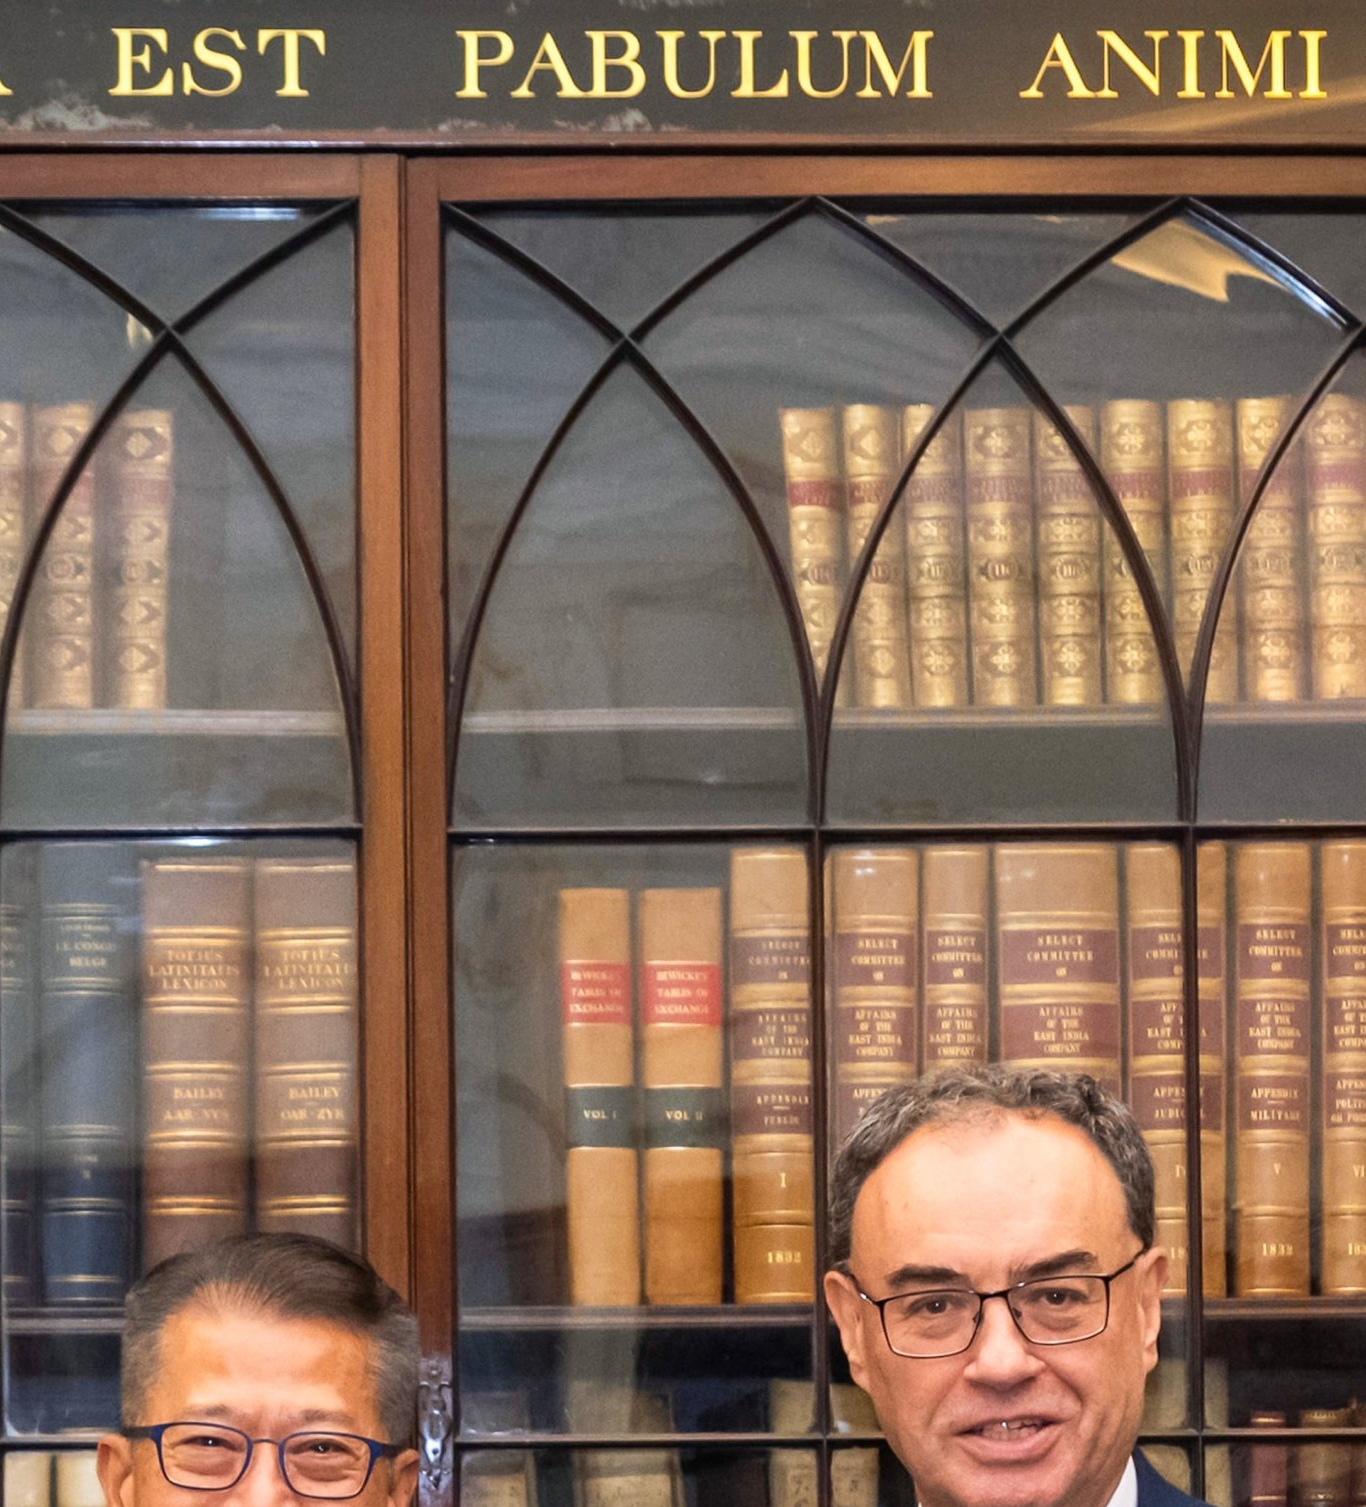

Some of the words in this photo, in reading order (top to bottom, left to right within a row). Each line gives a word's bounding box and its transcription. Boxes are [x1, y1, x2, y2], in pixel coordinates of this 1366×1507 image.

[108, 27, 325, 97] EST
[455, 30, 933, 98] PABULUM
[1018, 30, 1331, 100] ANIMI
[1255, 929, 1296, 940] SELECT
[858, 938, 898, 950] SELECT
[937, 936, 977, 947] SELECT
[1036, 935, 1084, 946] SELECT
[167, 950, 223, 962] TOTIUS
[283, 948, 341, 960] TOTIUS
[1026, 951, 1094, 962] COMMITTEE
[1248, 945, 1303, 957] COMMITTEE
[851, 955, 906, 966] COMMITTEE
[931, 952, 983, 963] COMMITTEE
[149, 964, 240, 977] LATINITATIS
[1270, 961, 1283, 972] ON
[1354, 960, 1366, 971] ON
[872, 971, 884, 982] ON
[952, 968, 965, 979] ON
[1055, 966, 1068, 977] ON
[161, 977, 228, 990] LEXICON
[279, 976, 345, 989] LEXICON
[571, 987, 605, 998] TABLES
[657, 987, 693, 998] TABLES
[568, 1003, 627, 1014] EXCHANGE
[654, 1003, 710, 1015] EXCHANGE
[936, 1007, 978, 1018] AFFAIRS
[1038, 1006, 1084, 1017] AFFAIRS
[1254, 1002, 1295, 1012] AFFAIRS
[854, 1009, 898, 1020] AFFAIRS
[1259, 1013, 1271, 1024] OF
[1273, 1014, 1291, 1025] THE
[1344, 1012, 1356, 1022] OF
[859, 1021, 869, 1032] OF
[875, 1021, 892, 1032] THE
[940, 1019, 952, 1030] OF
[955, 1019, 974, 1030] THE
[1045, 1018, 1057, 1030] OF
[1061, 1018, 1080, 1030] THE
[1146, 1028, 1172, 1038] EAST
[1248, 1026, 1272, 1037] EAST
[1276, 1026, 1302, 1037] INDIA
[1333, 1025, 1356, 1036] EAST
[848, 1034, 872, 1045] EAST
[877, 1034, 902, 1046] INDIA
[929, 1033, 952, 1044] EAST
[1033, 1031, 1056, 1042] EAST
[1062, 1031, 1090, 1042] INDIA
[1043, 1043, 1081, 1054] COMPANY
[1257, 1039, 1295, 1049] COMPANY
[761, 1047, 803, 1057] COMPANY
[856, 1046, 895, 1057] COMPANY
[937, 1046, 976, 1057] COMPANY
[173, 1086, 224, 1099] BAILEY
[288, 1086, 342, 1099] BAILEY
[1250, 1087, 1299, 1099] APPENDIX
[583, 1109, 607, 1120] VOL
[665, 1109, 690, 1121] VOL
[1250, 1109, 1301, 1121] MILITARY
[1273, 1162, 1282, 1175] V
[1352, 1164, 1365, 1178] VI
[779, 1172, 787, 1188] I
